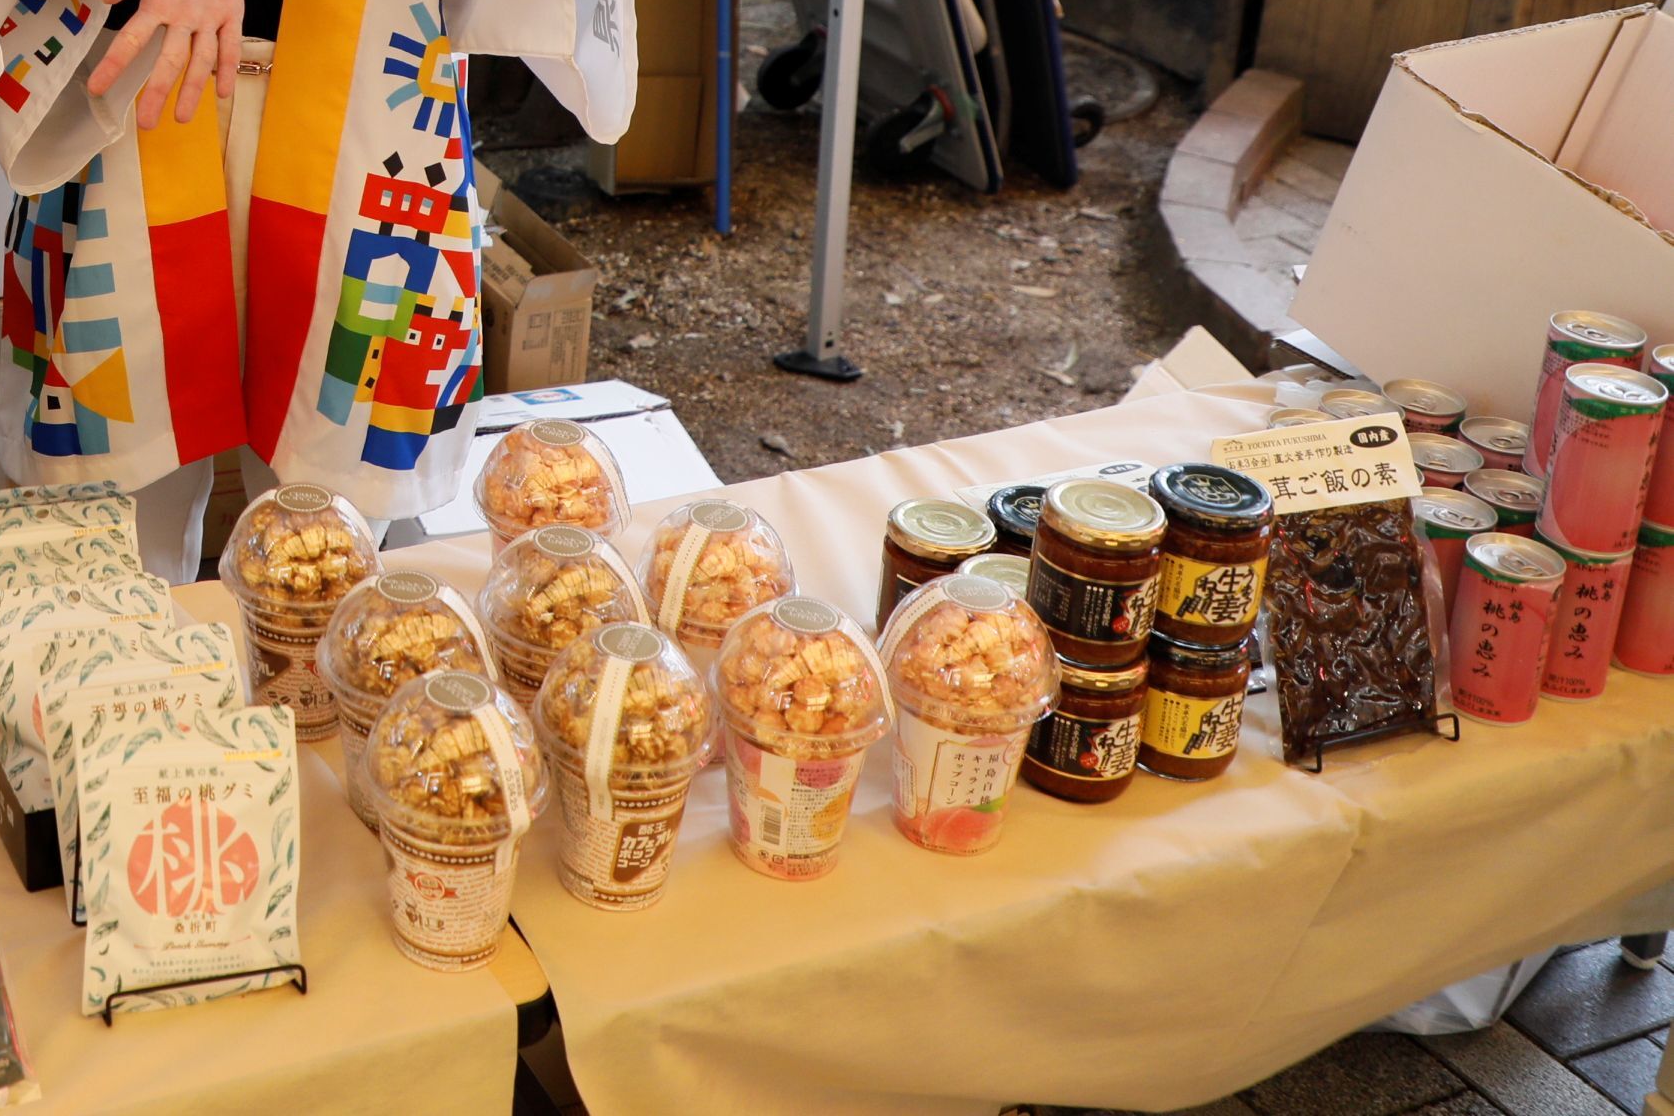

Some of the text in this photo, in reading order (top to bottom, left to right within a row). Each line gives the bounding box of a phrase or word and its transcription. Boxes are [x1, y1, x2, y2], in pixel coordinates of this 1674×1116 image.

[1247, 433, 1327, 451] YOUKIYA FUKUSHIMA
[1269, 462, 1398, 500] 茸ご飯の素
[1472, 598, 1506, 678] 桃の恵み
[1564, 583, 1599, 660] 桃の恵み
[132, 782, 254, 805] 至福の桃グミ
[134, 800, 248, 918] 桃
[617, 858, 651, 869] コーン
